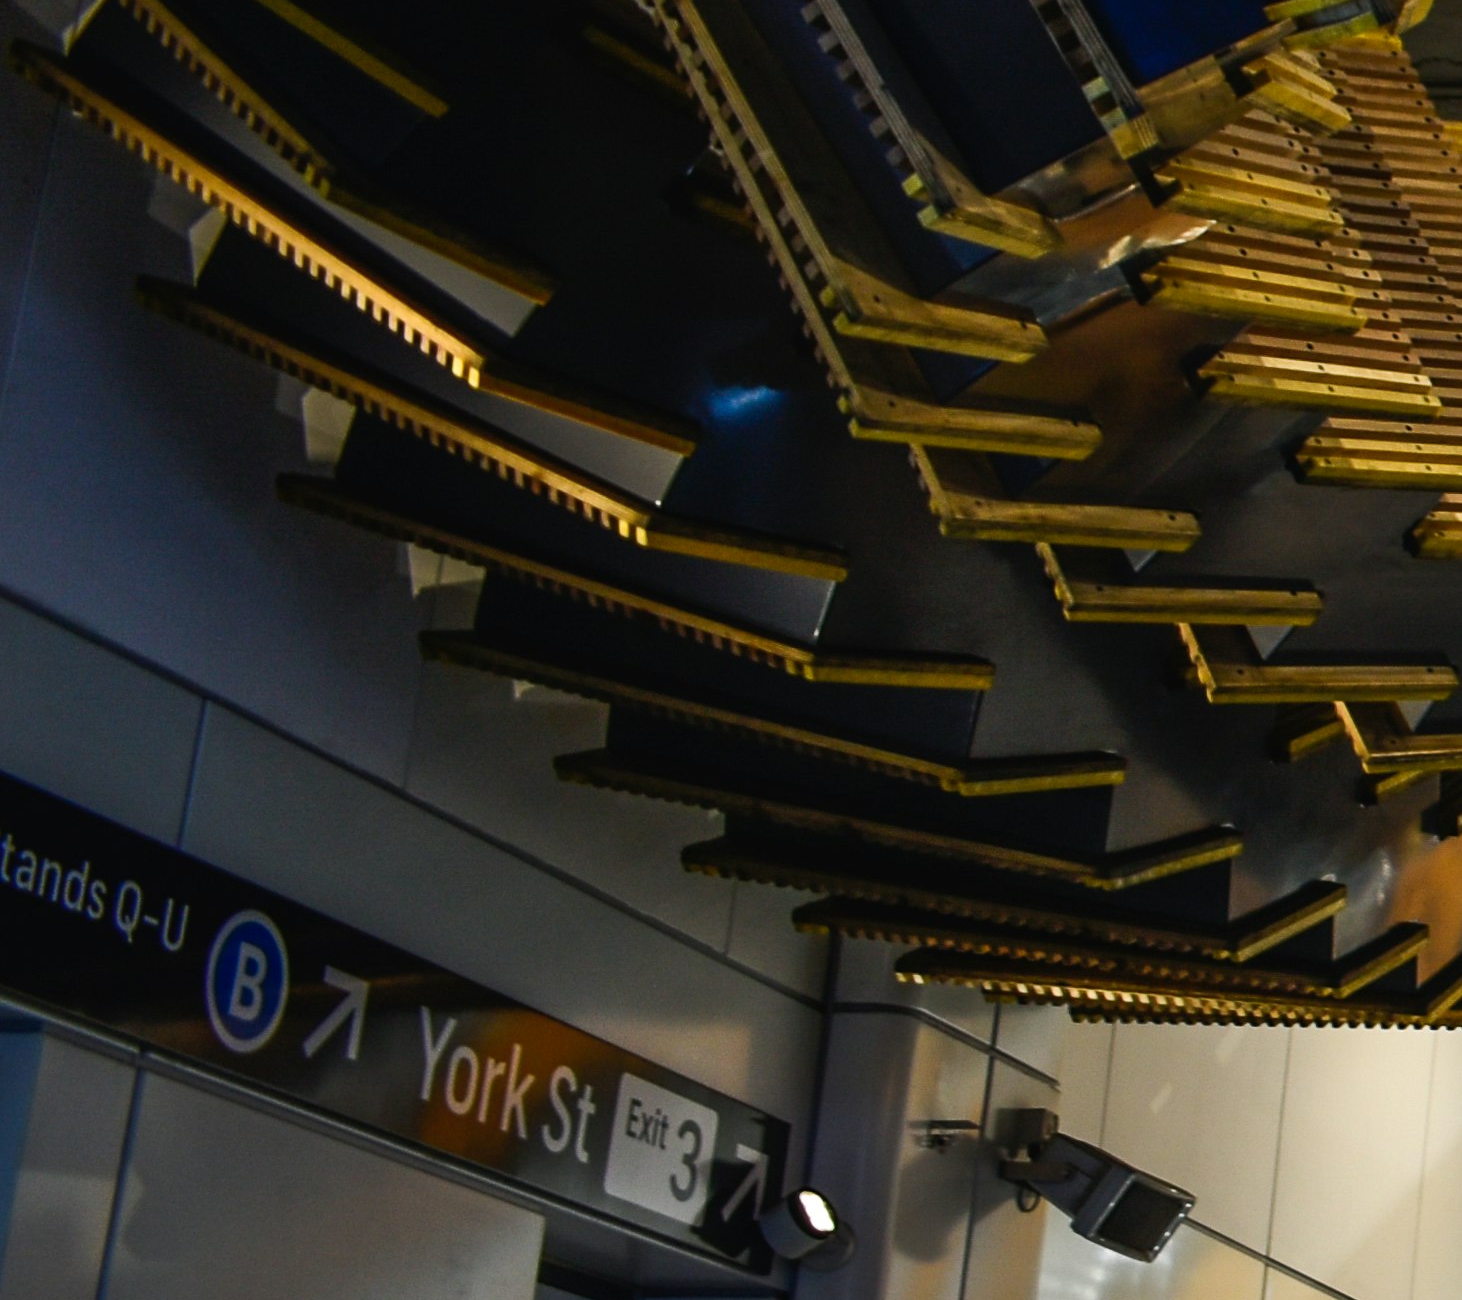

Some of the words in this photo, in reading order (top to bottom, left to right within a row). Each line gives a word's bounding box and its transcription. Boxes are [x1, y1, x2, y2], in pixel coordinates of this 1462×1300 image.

[0, 833, 107, 920] tands
[114, 880, 189, 951] Q-U
[228, 941, 267, 1021] B
[420, 1005, 536, 1140] York
[541, 1065, 596, 1164] St
[625, 1098, 669, 1150] Exit
[669, 1118, 703, 1202] 3
